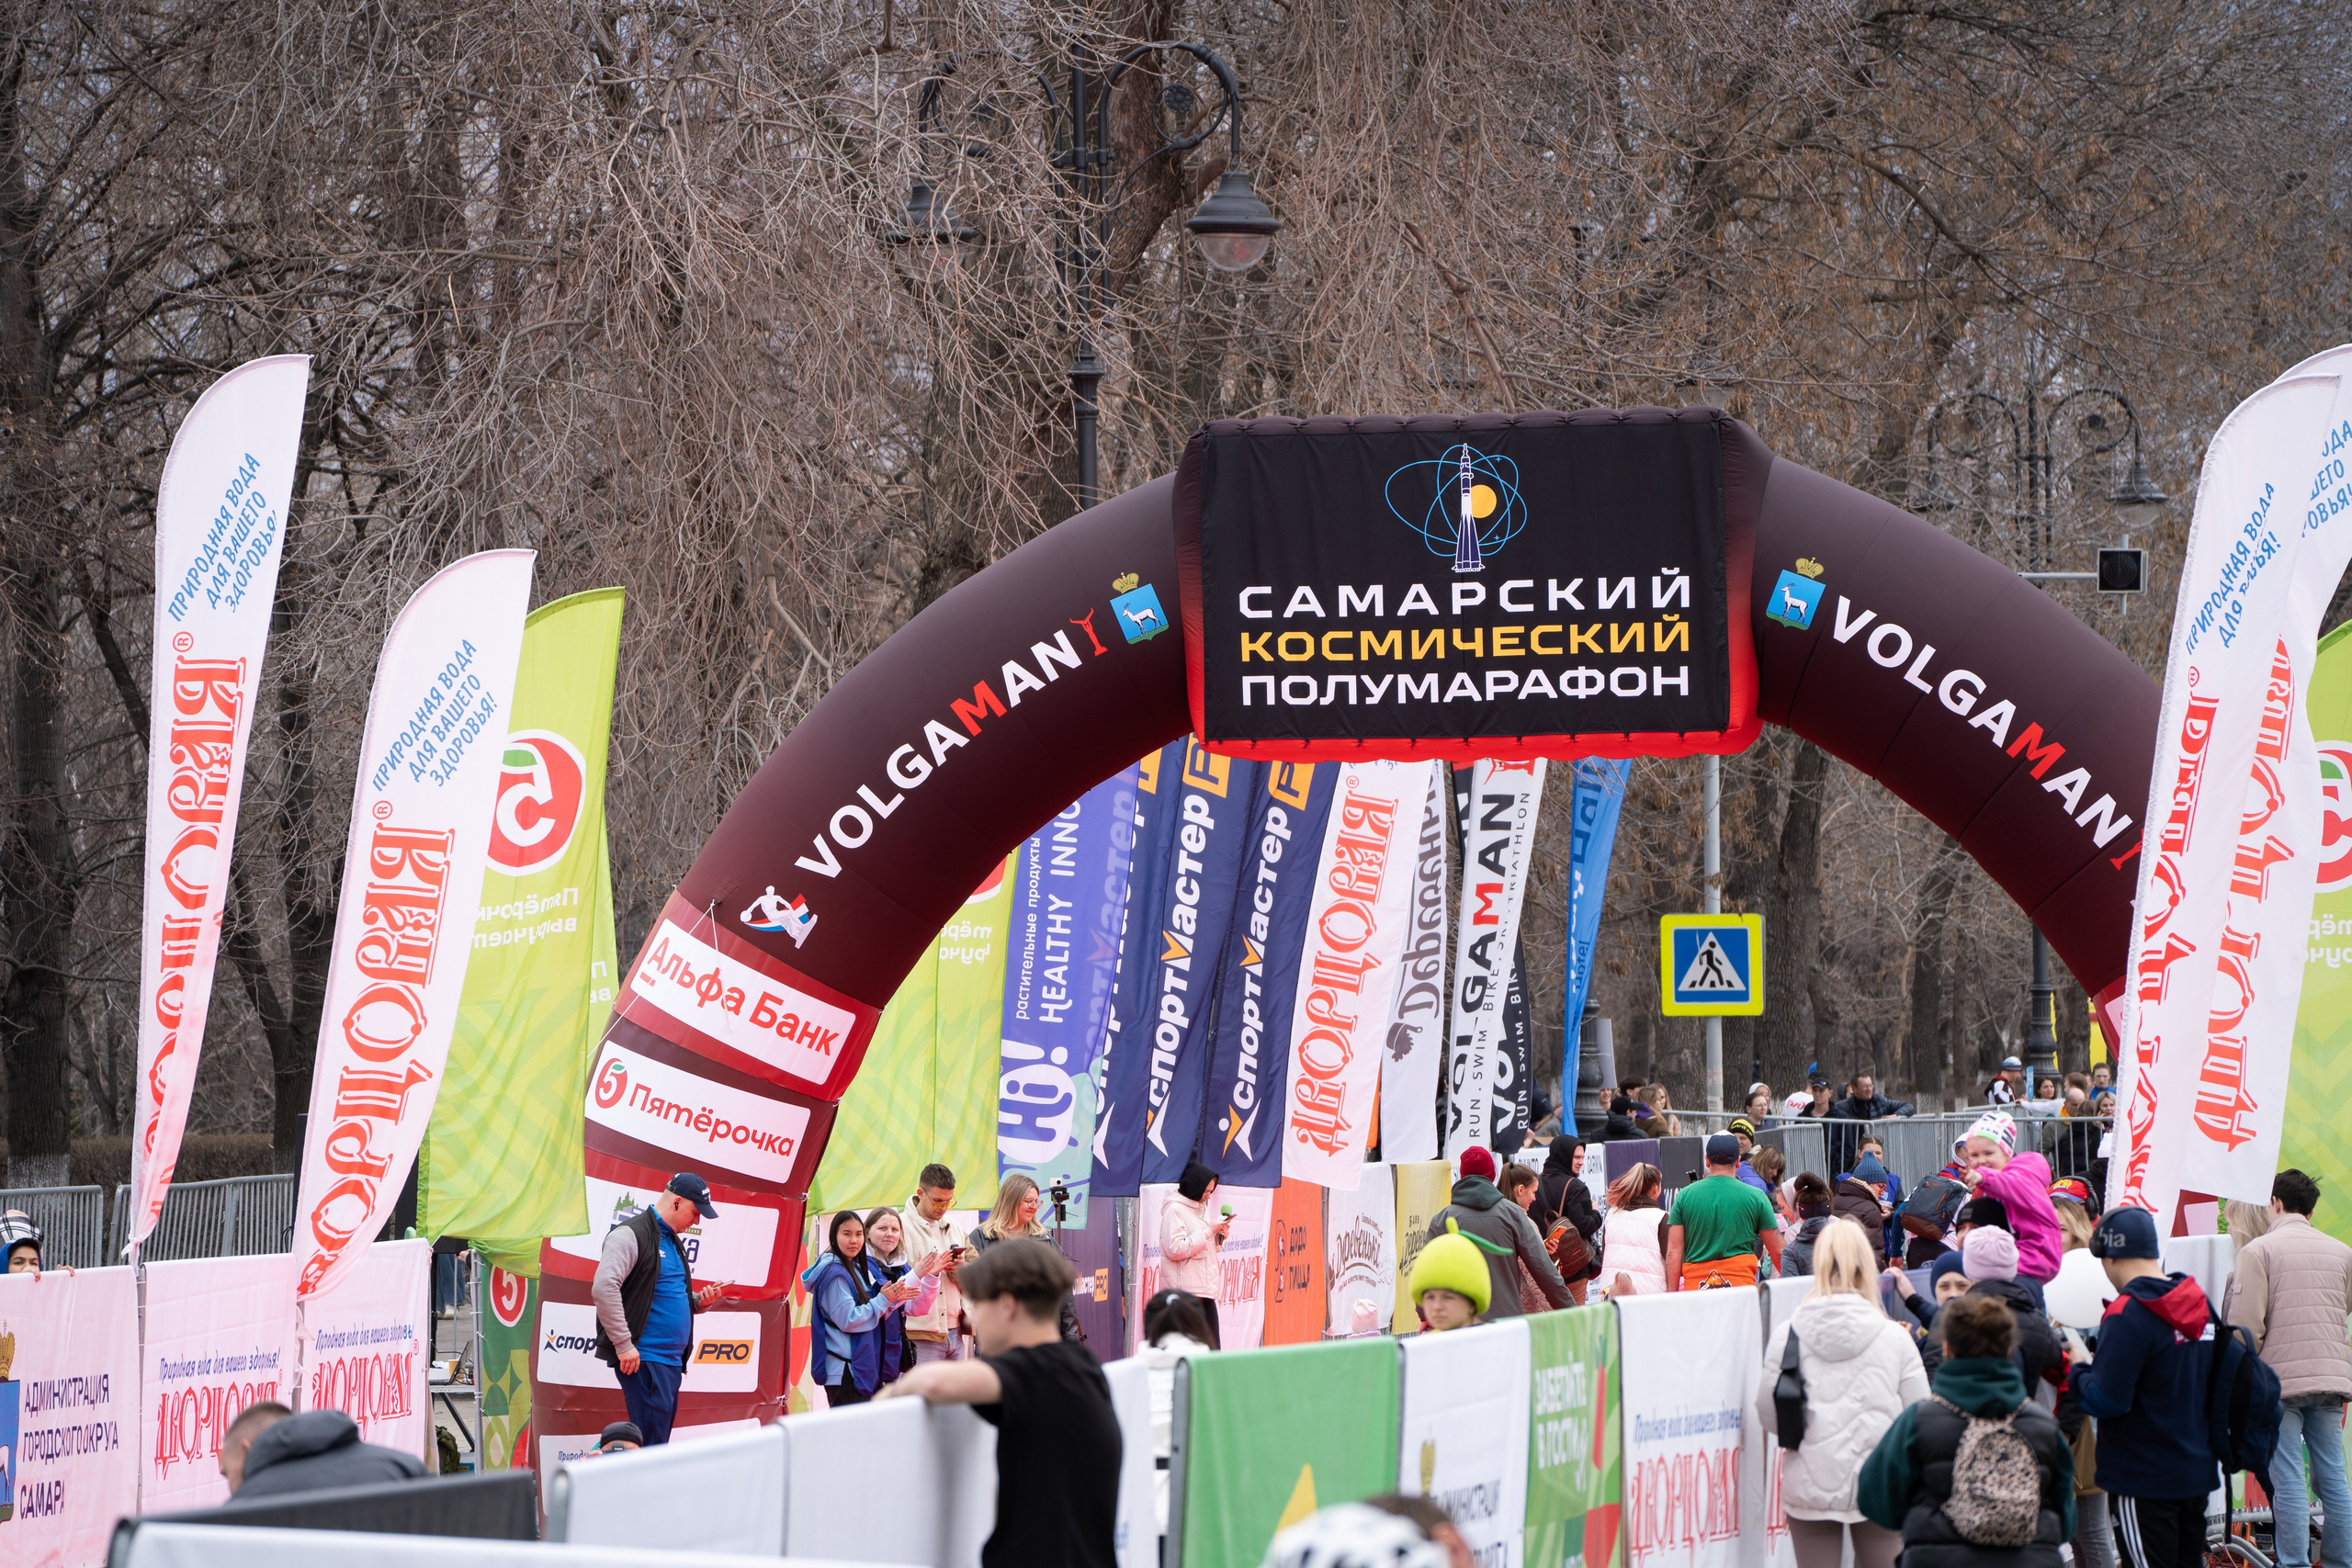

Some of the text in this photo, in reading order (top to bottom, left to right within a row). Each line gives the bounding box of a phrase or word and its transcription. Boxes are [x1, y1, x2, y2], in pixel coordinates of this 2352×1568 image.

[168, 453, 260, 622] ПРИРОДНАЯ ВОДА
[207, 491, 266, 610] ДЛЯ ВАШЕГО
[226, 510, 277, 614] ЗДОРОВЬЯ!
[2186, 541, 2251, 655] ПРИРОДНАЯ
[2244, 482, 2274, 541] ВОДА
[1238, 567, 1690, 619] САМАРСКИЙ
[1240, 614, 1690, 663] КОСМИЧЕСКИЙ
[2219, 600, 2243, 648] ДЛЯ
[372, 638, 477, 792] ПРИРОДНАЯ ВОДА
[408, 674, 481, 783] ДЛЯ ВАШЕГО
[1242, 666, 1690, 707] ПОЛУМАРАФОН
[1833, 595, 2133, 849] VOLGAMAN
[430, 691, 498, 786] ЗДОРОВЬЯ!
[794, 629, 1082, 879] VOLGAMAN
[1015, 837, 1041, 1021] растительные продукты
[1039, 894, 1073, 1023] HEALTHY
[1290, 791, 1399, 1157] ДВОРЦОВАЯ
[647, 936, 840, 1056] Альфа Банк
[1483, 968, 1499, 1010] BIKE
[296, 825, 457, 1296] ВОРЦОВАЯ
[1472, 1029, 1487, 1080] SWIM
[1515, 1021, 1525, 1071] SWIM
[628, 1083, 795, 1157] Пятёрочка
[1469, 1099, 1481, 1137] RUN
[1518, 1089, 1529, 1129] RUN
[25, 1374, 109, 1418] АДМИНИСТРАЦИЯ
[698, 1343, 750, 1361] PRO
[23, 1426, 82, 1465] ГОРОДСКОГО
